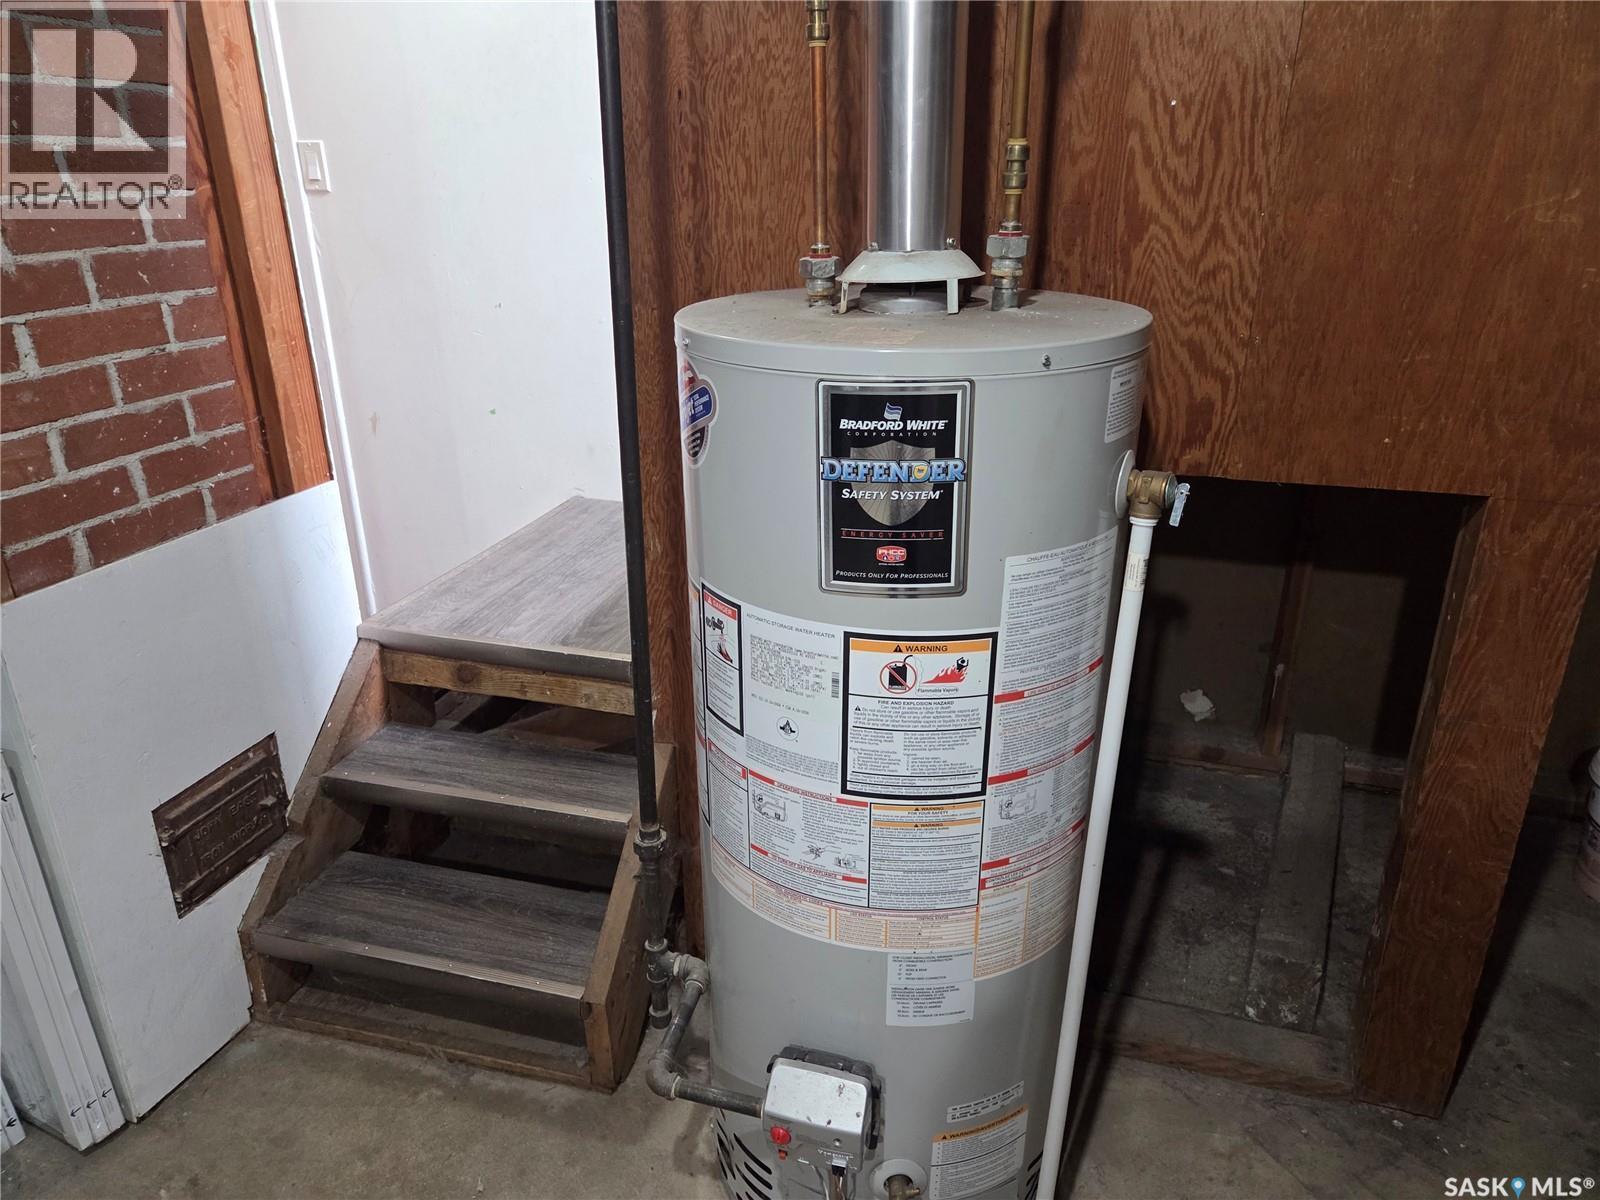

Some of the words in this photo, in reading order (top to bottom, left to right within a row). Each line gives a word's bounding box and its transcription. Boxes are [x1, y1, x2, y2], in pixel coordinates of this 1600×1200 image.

[839, 418, 903, 431] BRADFORD
[821, 458, 966, 483] DEFENDER
[841, 488, 887, 500] SAFETY
[842, 530, 893, 538] ENERGY
[902, 531, 944, 539] SAVER
[835, 570, 866, 578] PRODUCTS
[746, 612, 771, 625] AUTOMATIC
[771, 620, 794, 631] STORAGE
[794, 627, 813, 635] WATER
[814, 630, 836, 639] HEATER
